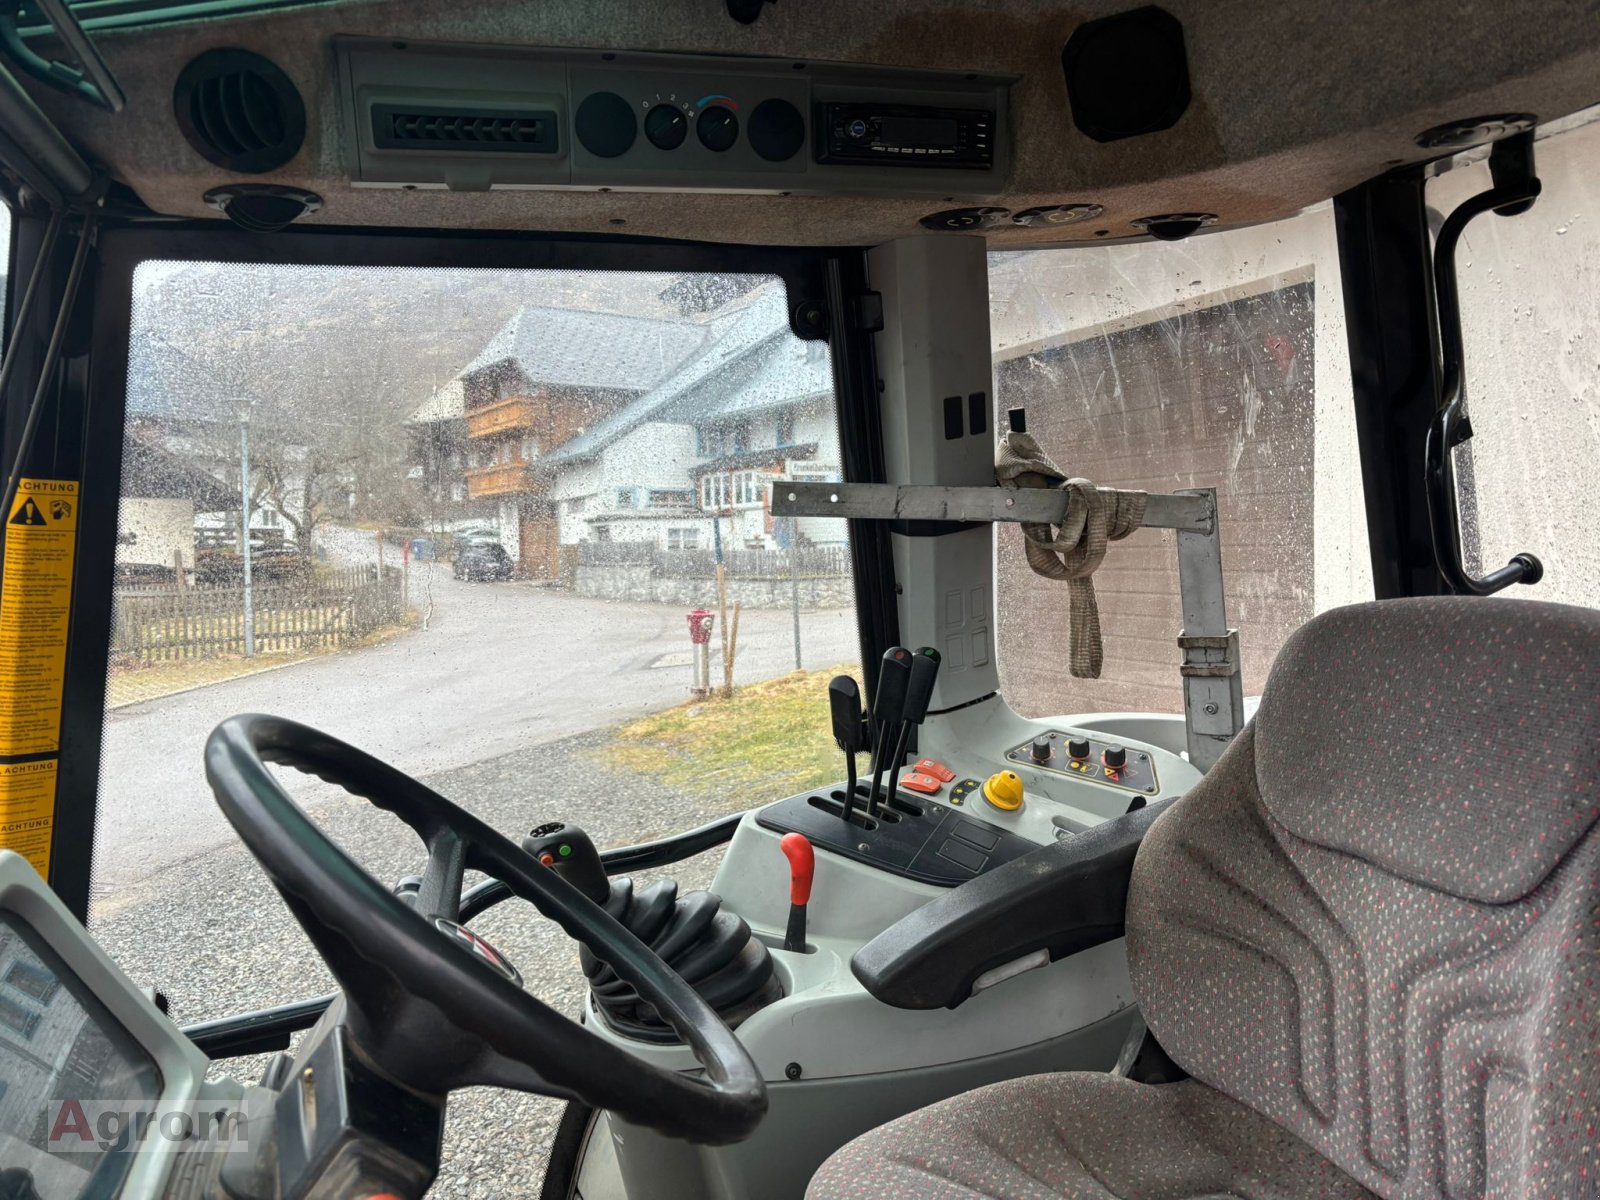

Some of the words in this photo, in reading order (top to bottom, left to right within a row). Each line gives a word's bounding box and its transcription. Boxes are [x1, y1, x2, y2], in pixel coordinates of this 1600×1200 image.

[17, 481, 74, 492] CHTUNG
[5, 762, 54, 774] ACHTUNG
[1, 819, 49, 832] ACHTUNG
